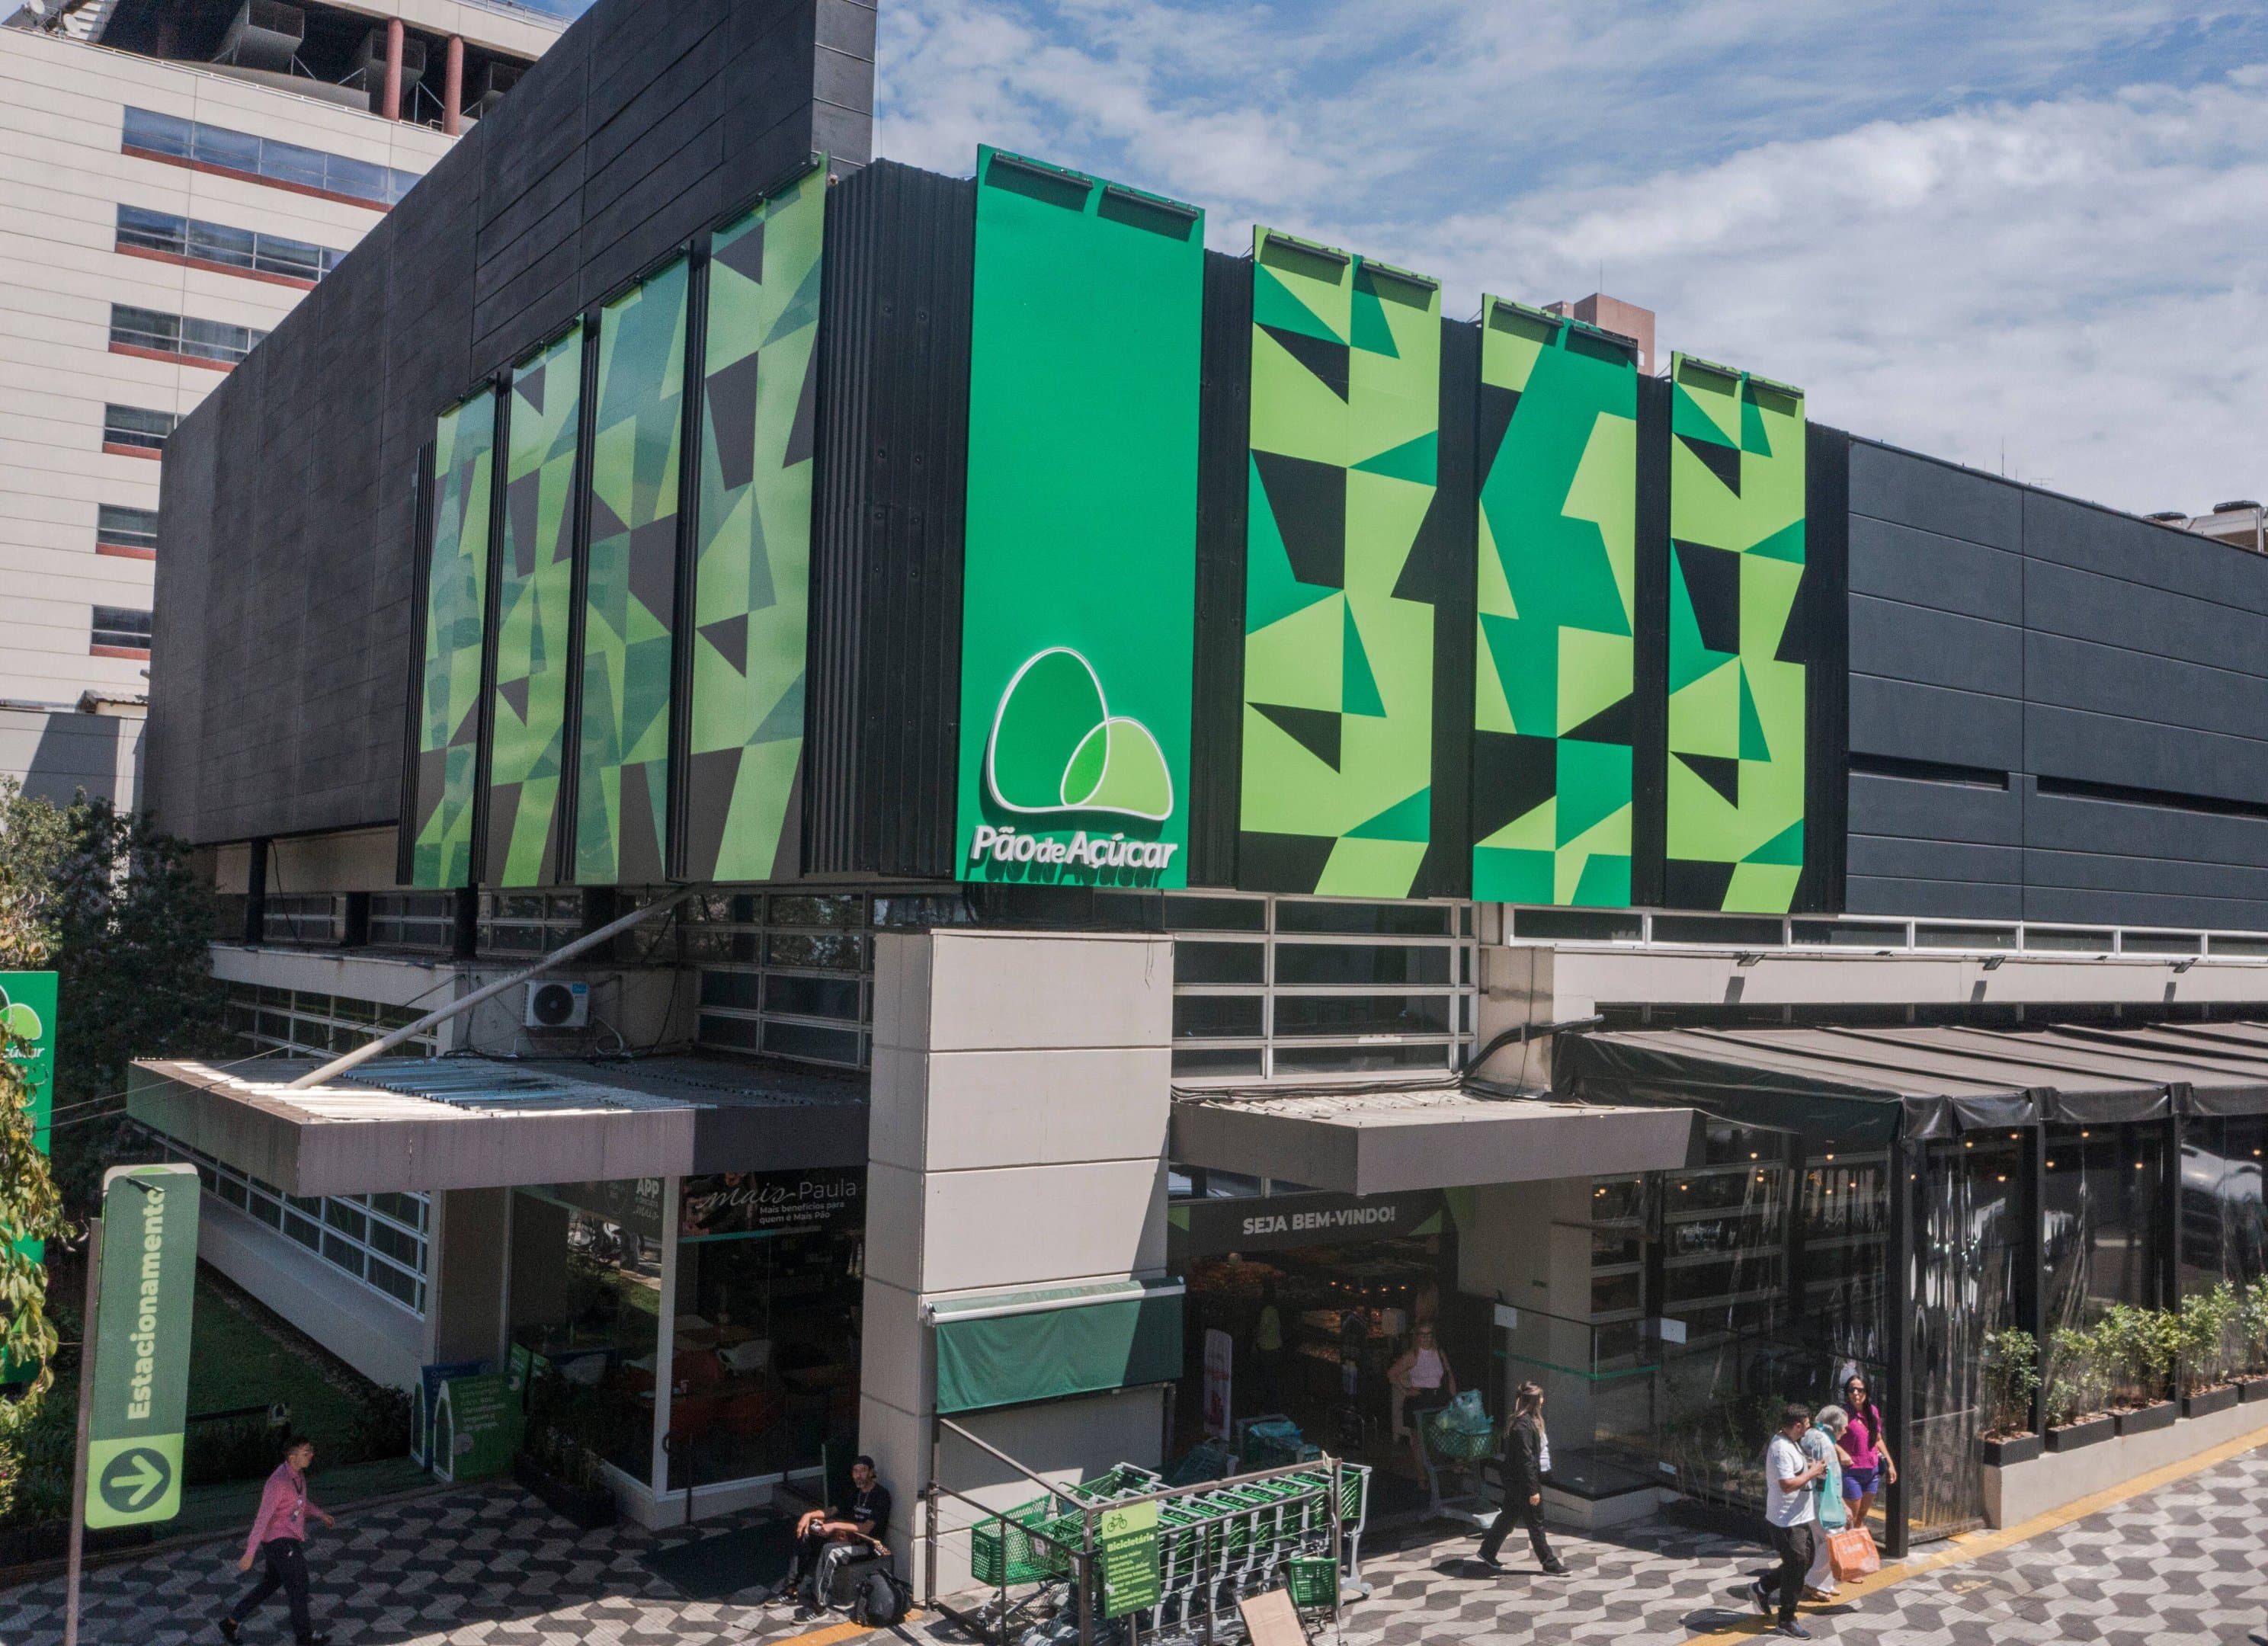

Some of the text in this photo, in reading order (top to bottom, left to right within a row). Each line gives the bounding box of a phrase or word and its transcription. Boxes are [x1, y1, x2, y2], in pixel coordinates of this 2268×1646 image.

[970, 825, 1178, 869] Pão de Açúcar
[799, 1178, 857, 1200] Paula
[793, 1212, 812, 1221] Mais
[826, 1201, 844, 1210] para
[1242, 1206, 1396, 1235] SEJA BEM-VINDO!
